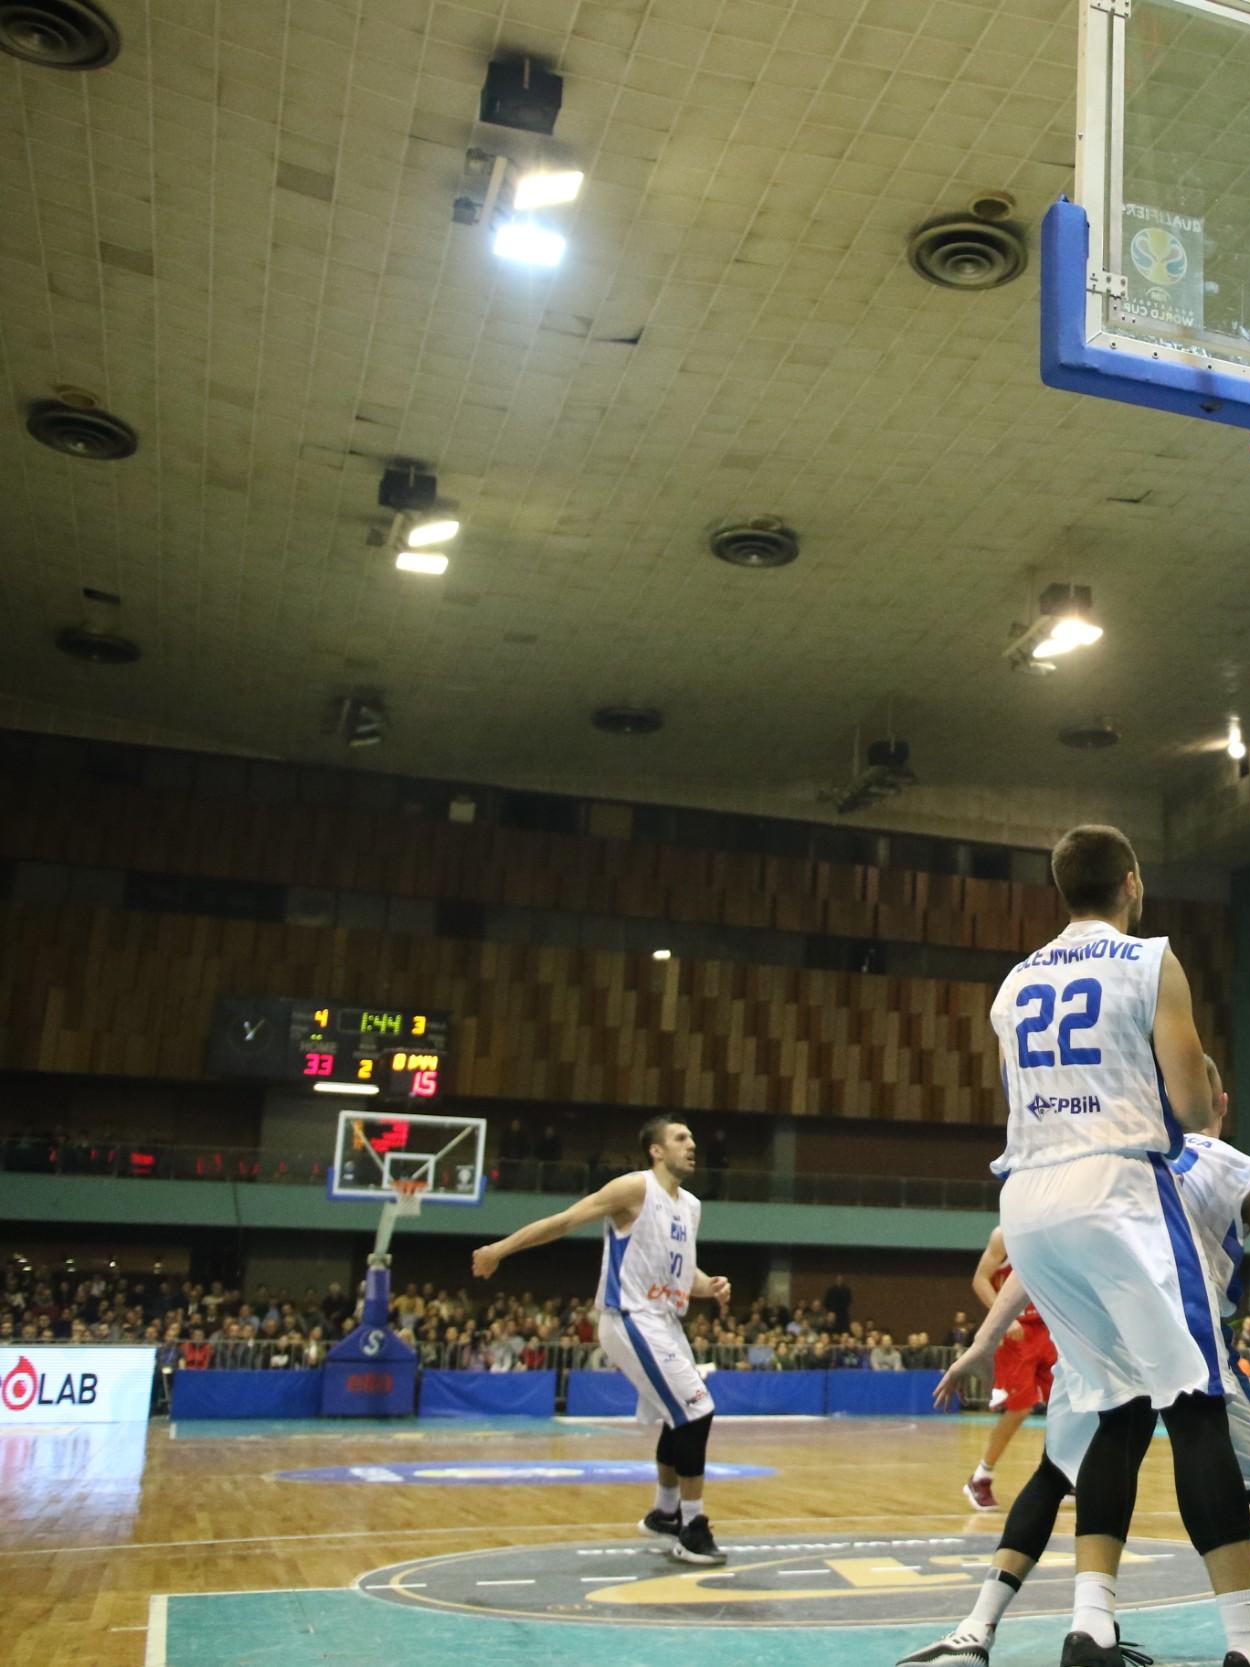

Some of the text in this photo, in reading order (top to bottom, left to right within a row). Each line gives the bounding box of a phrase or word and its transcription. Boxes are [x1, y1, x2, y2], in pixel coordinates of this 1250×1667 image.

[314, 1009, 329, 1028] 4
[412, 1015, 426, 1035] 3
[1016, 978, 1102, 1068] 22
[304, 1053, 335, 1076] 33
[357, 1059, 373, 1079] 2
